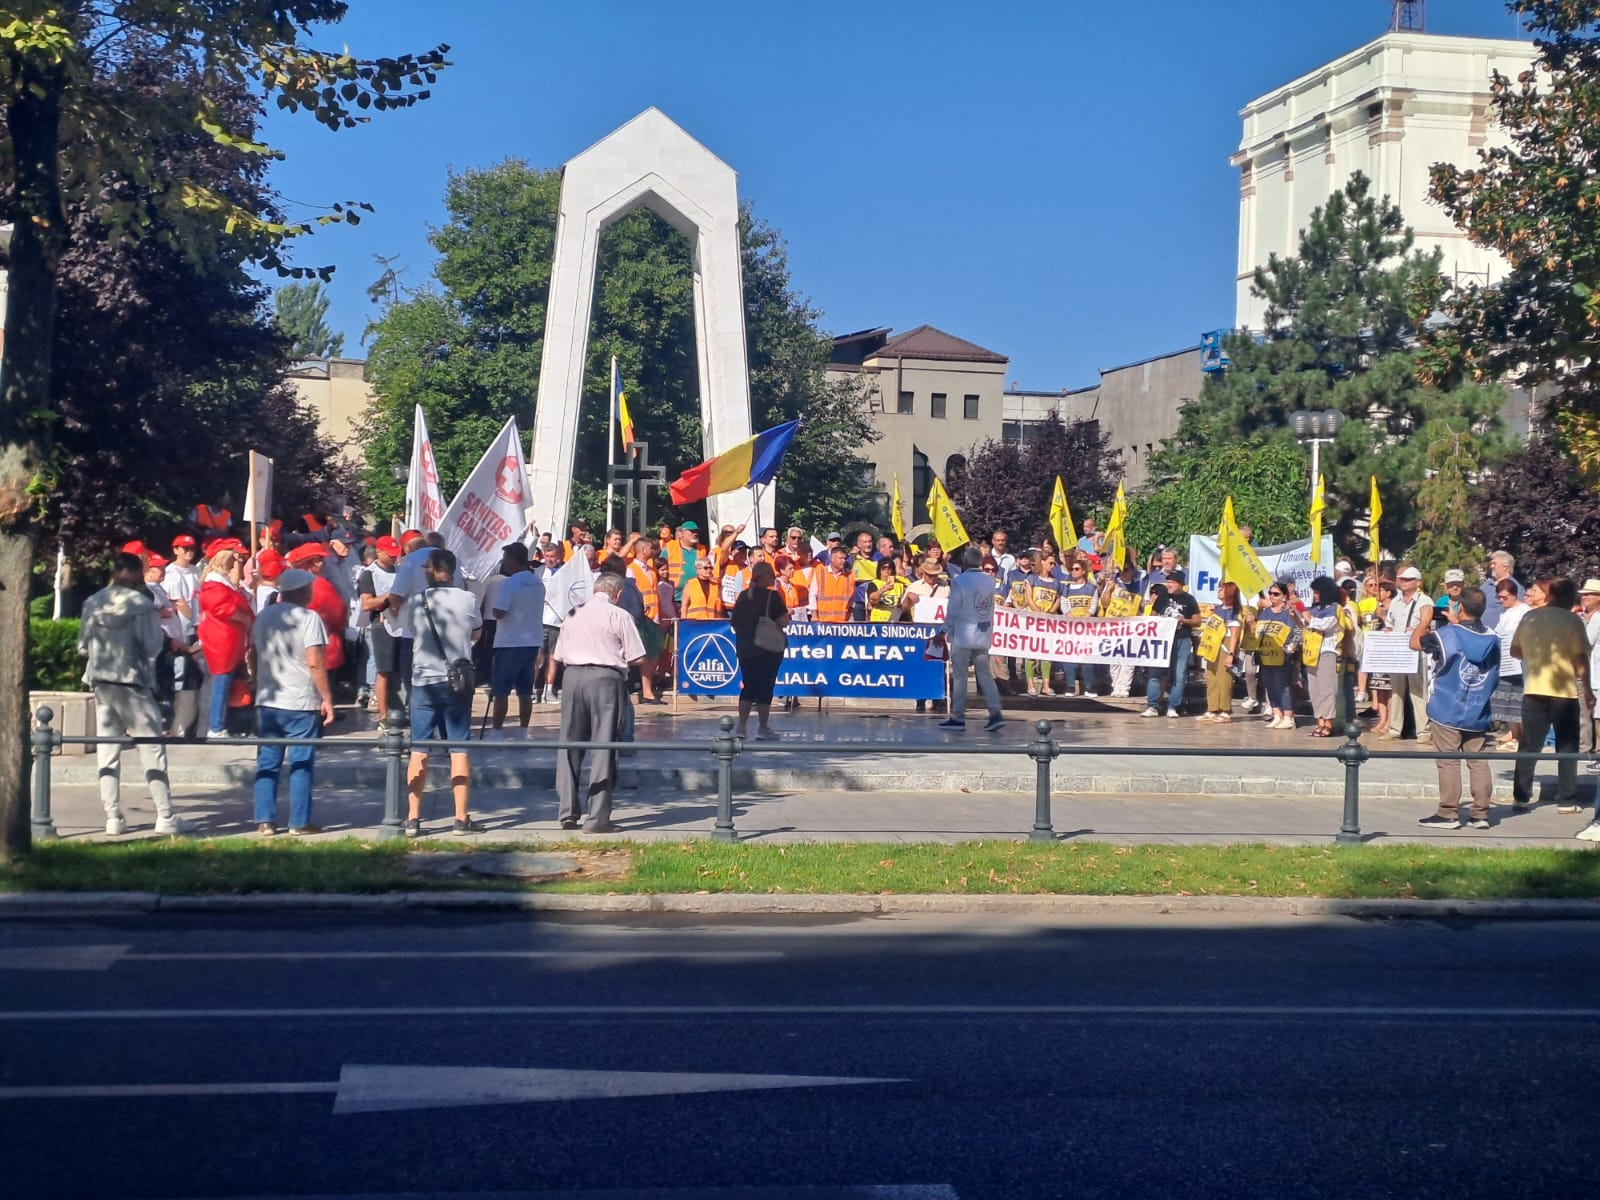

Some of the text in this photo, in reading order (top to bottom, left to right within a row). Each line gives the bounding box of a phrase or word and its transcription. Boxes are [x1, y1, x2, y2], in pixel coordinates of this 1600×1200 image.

[463, 492, 512, 541] SANITAS
[817, 625, 878, 638] NATIONALA
[881, 625, 937, 640] SINDICALA
[991, 631, 1050, 654] GISTUL
[1098, 638, 1168, 660] GALATI
[698, 658, 724, 671] alfa
[693, 674, 728, 682] CARTEL
[838, 673, 904, 688] GALATI
